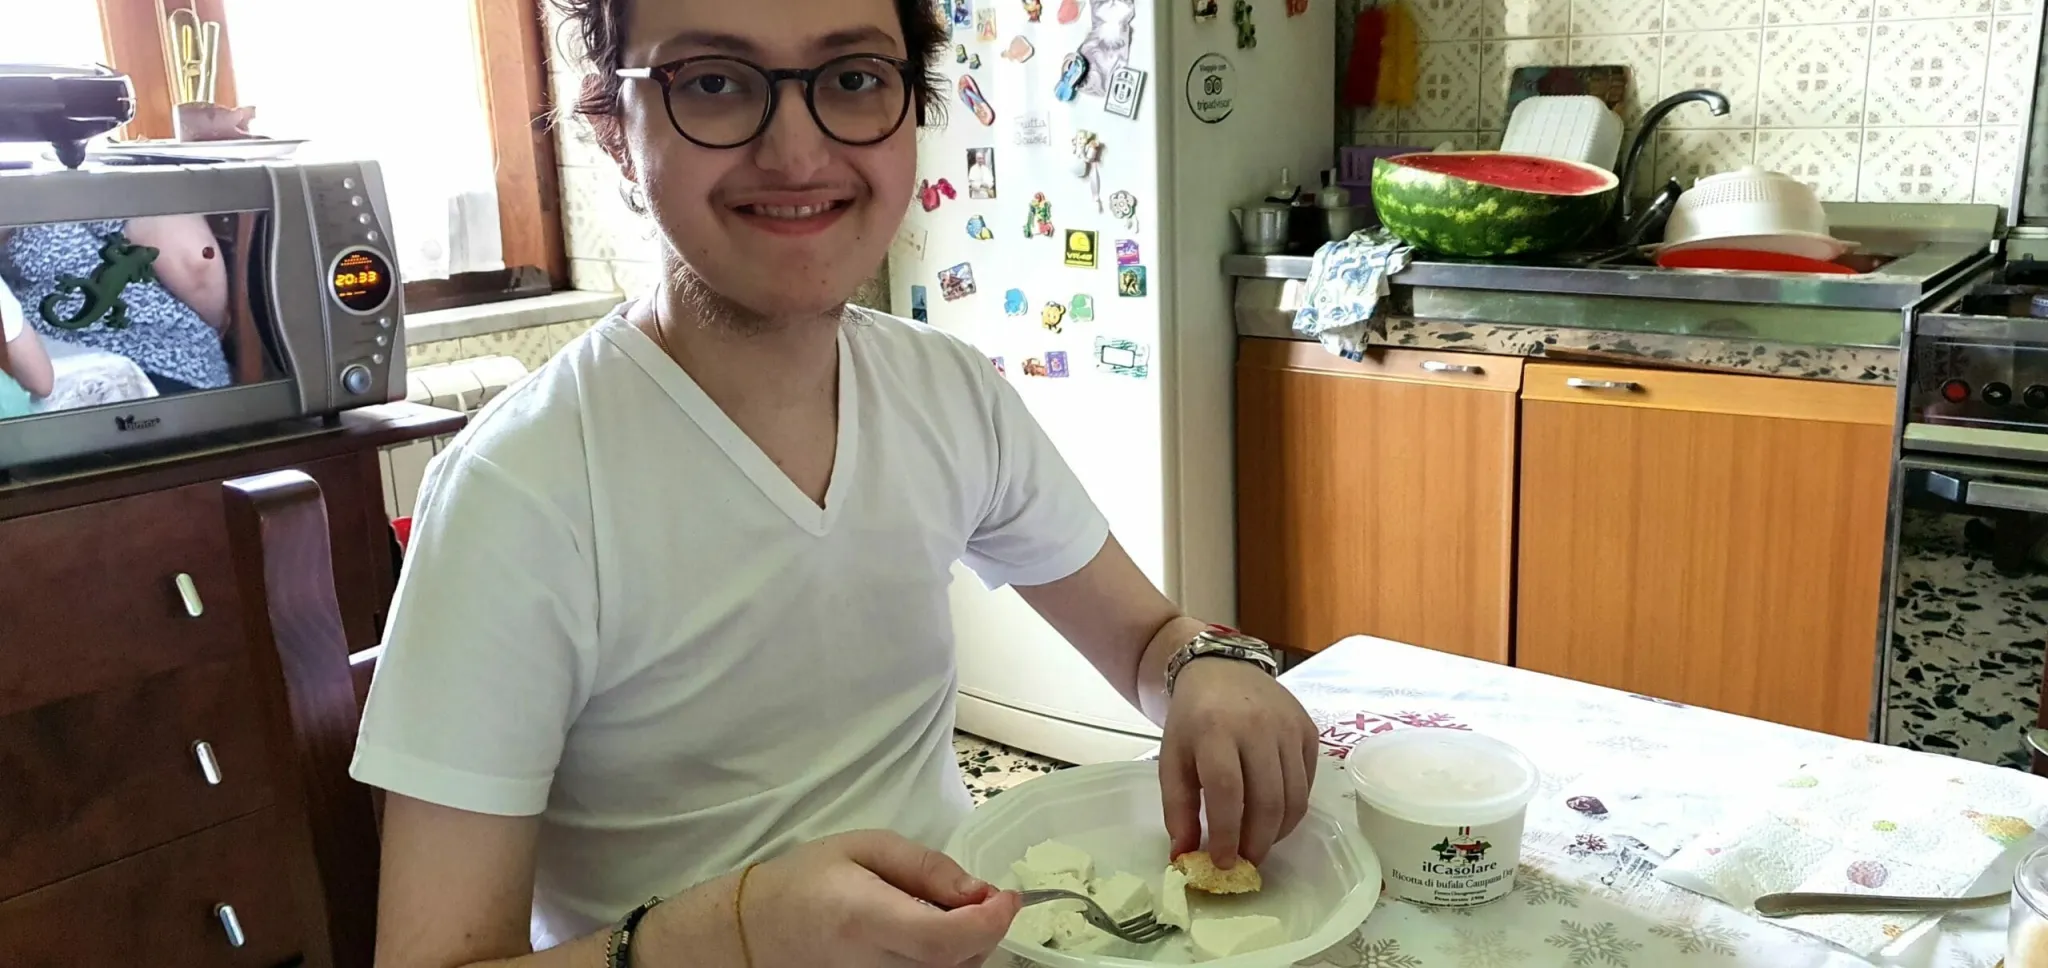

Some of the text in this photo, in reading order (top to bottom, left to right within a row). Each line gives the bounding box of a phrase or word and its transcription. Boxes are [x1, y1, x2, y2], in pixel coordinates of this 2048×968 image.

[1197, 99, 1230, 112] tripadvisor
[335, 271, 377, 287] 20:33
[1392, 869, 1423, 886] Ricotta
[1425, 879, 1434, 887] di
[1436, 880, 1464, 889] bufala
[1465, 873, 1502, 889] Campana
